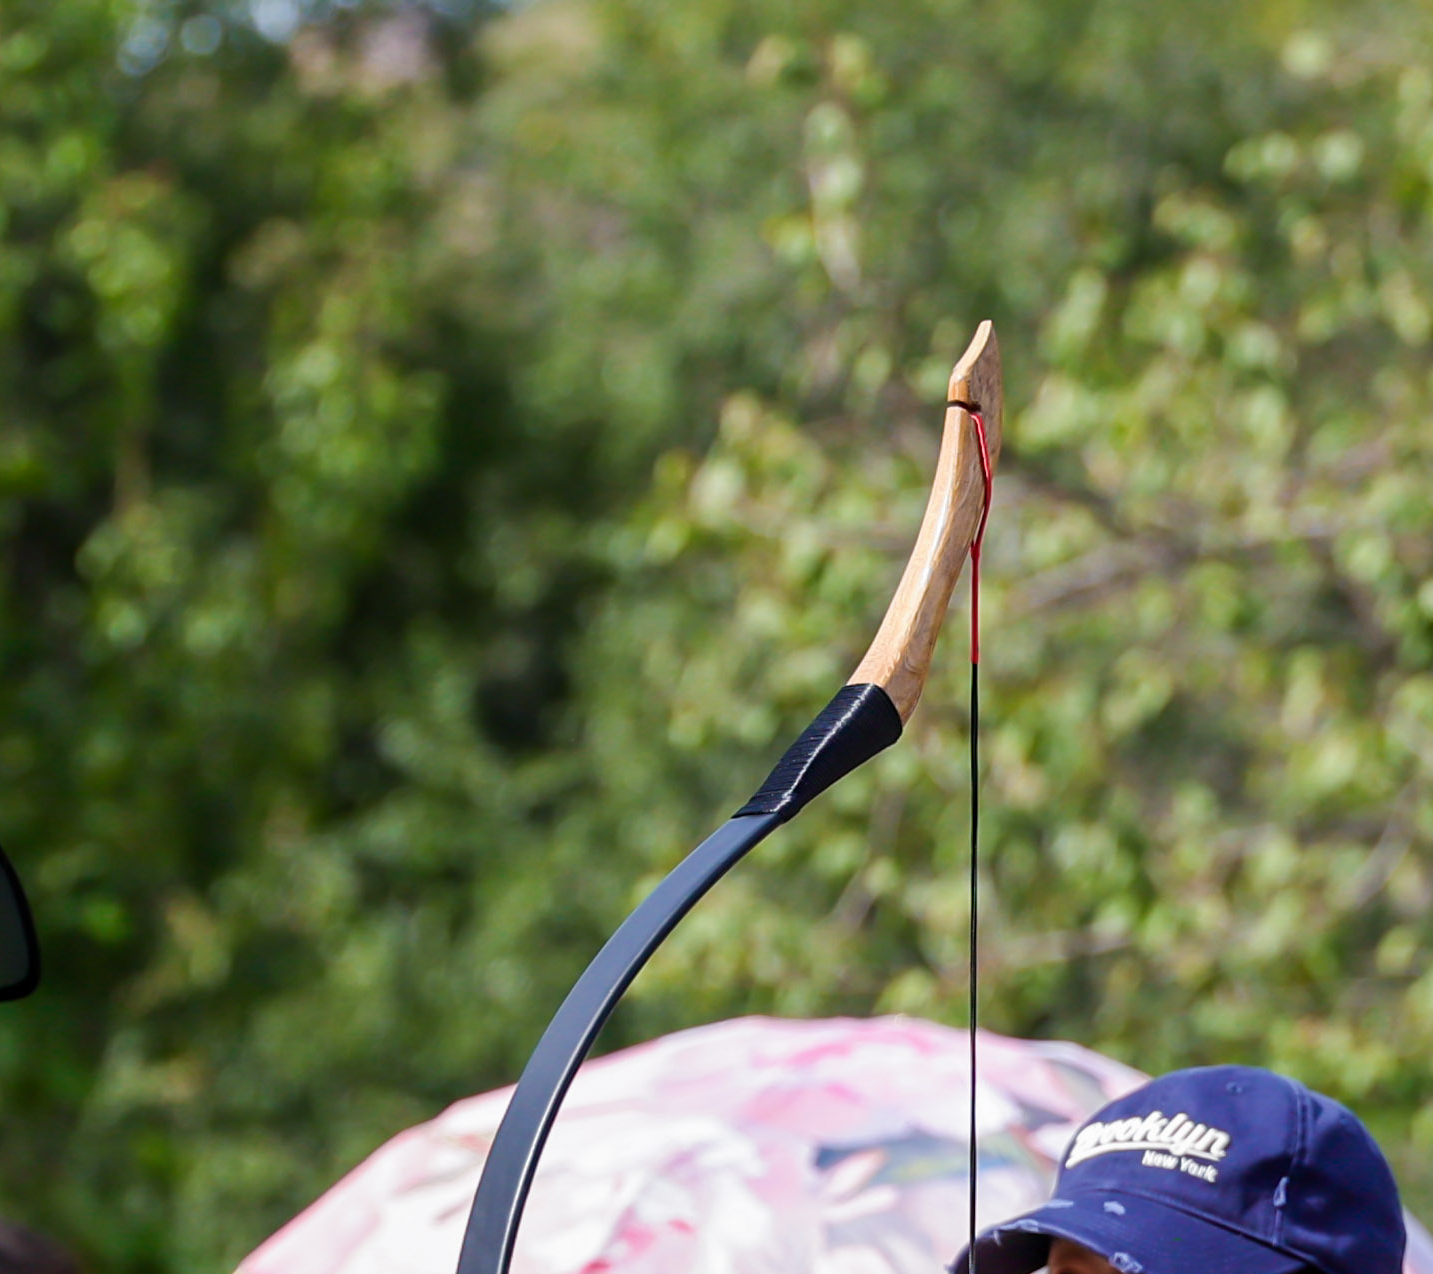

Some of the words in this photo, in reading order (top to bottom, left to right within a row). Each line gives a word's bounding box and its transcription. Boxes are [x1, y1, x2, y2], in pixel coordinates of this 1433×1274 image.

[1066, 1110, 1231, 1169] Brooklyn
[1141, 1150, 1179, 1170] New
[1180, 1156, 1219, 1183] York
